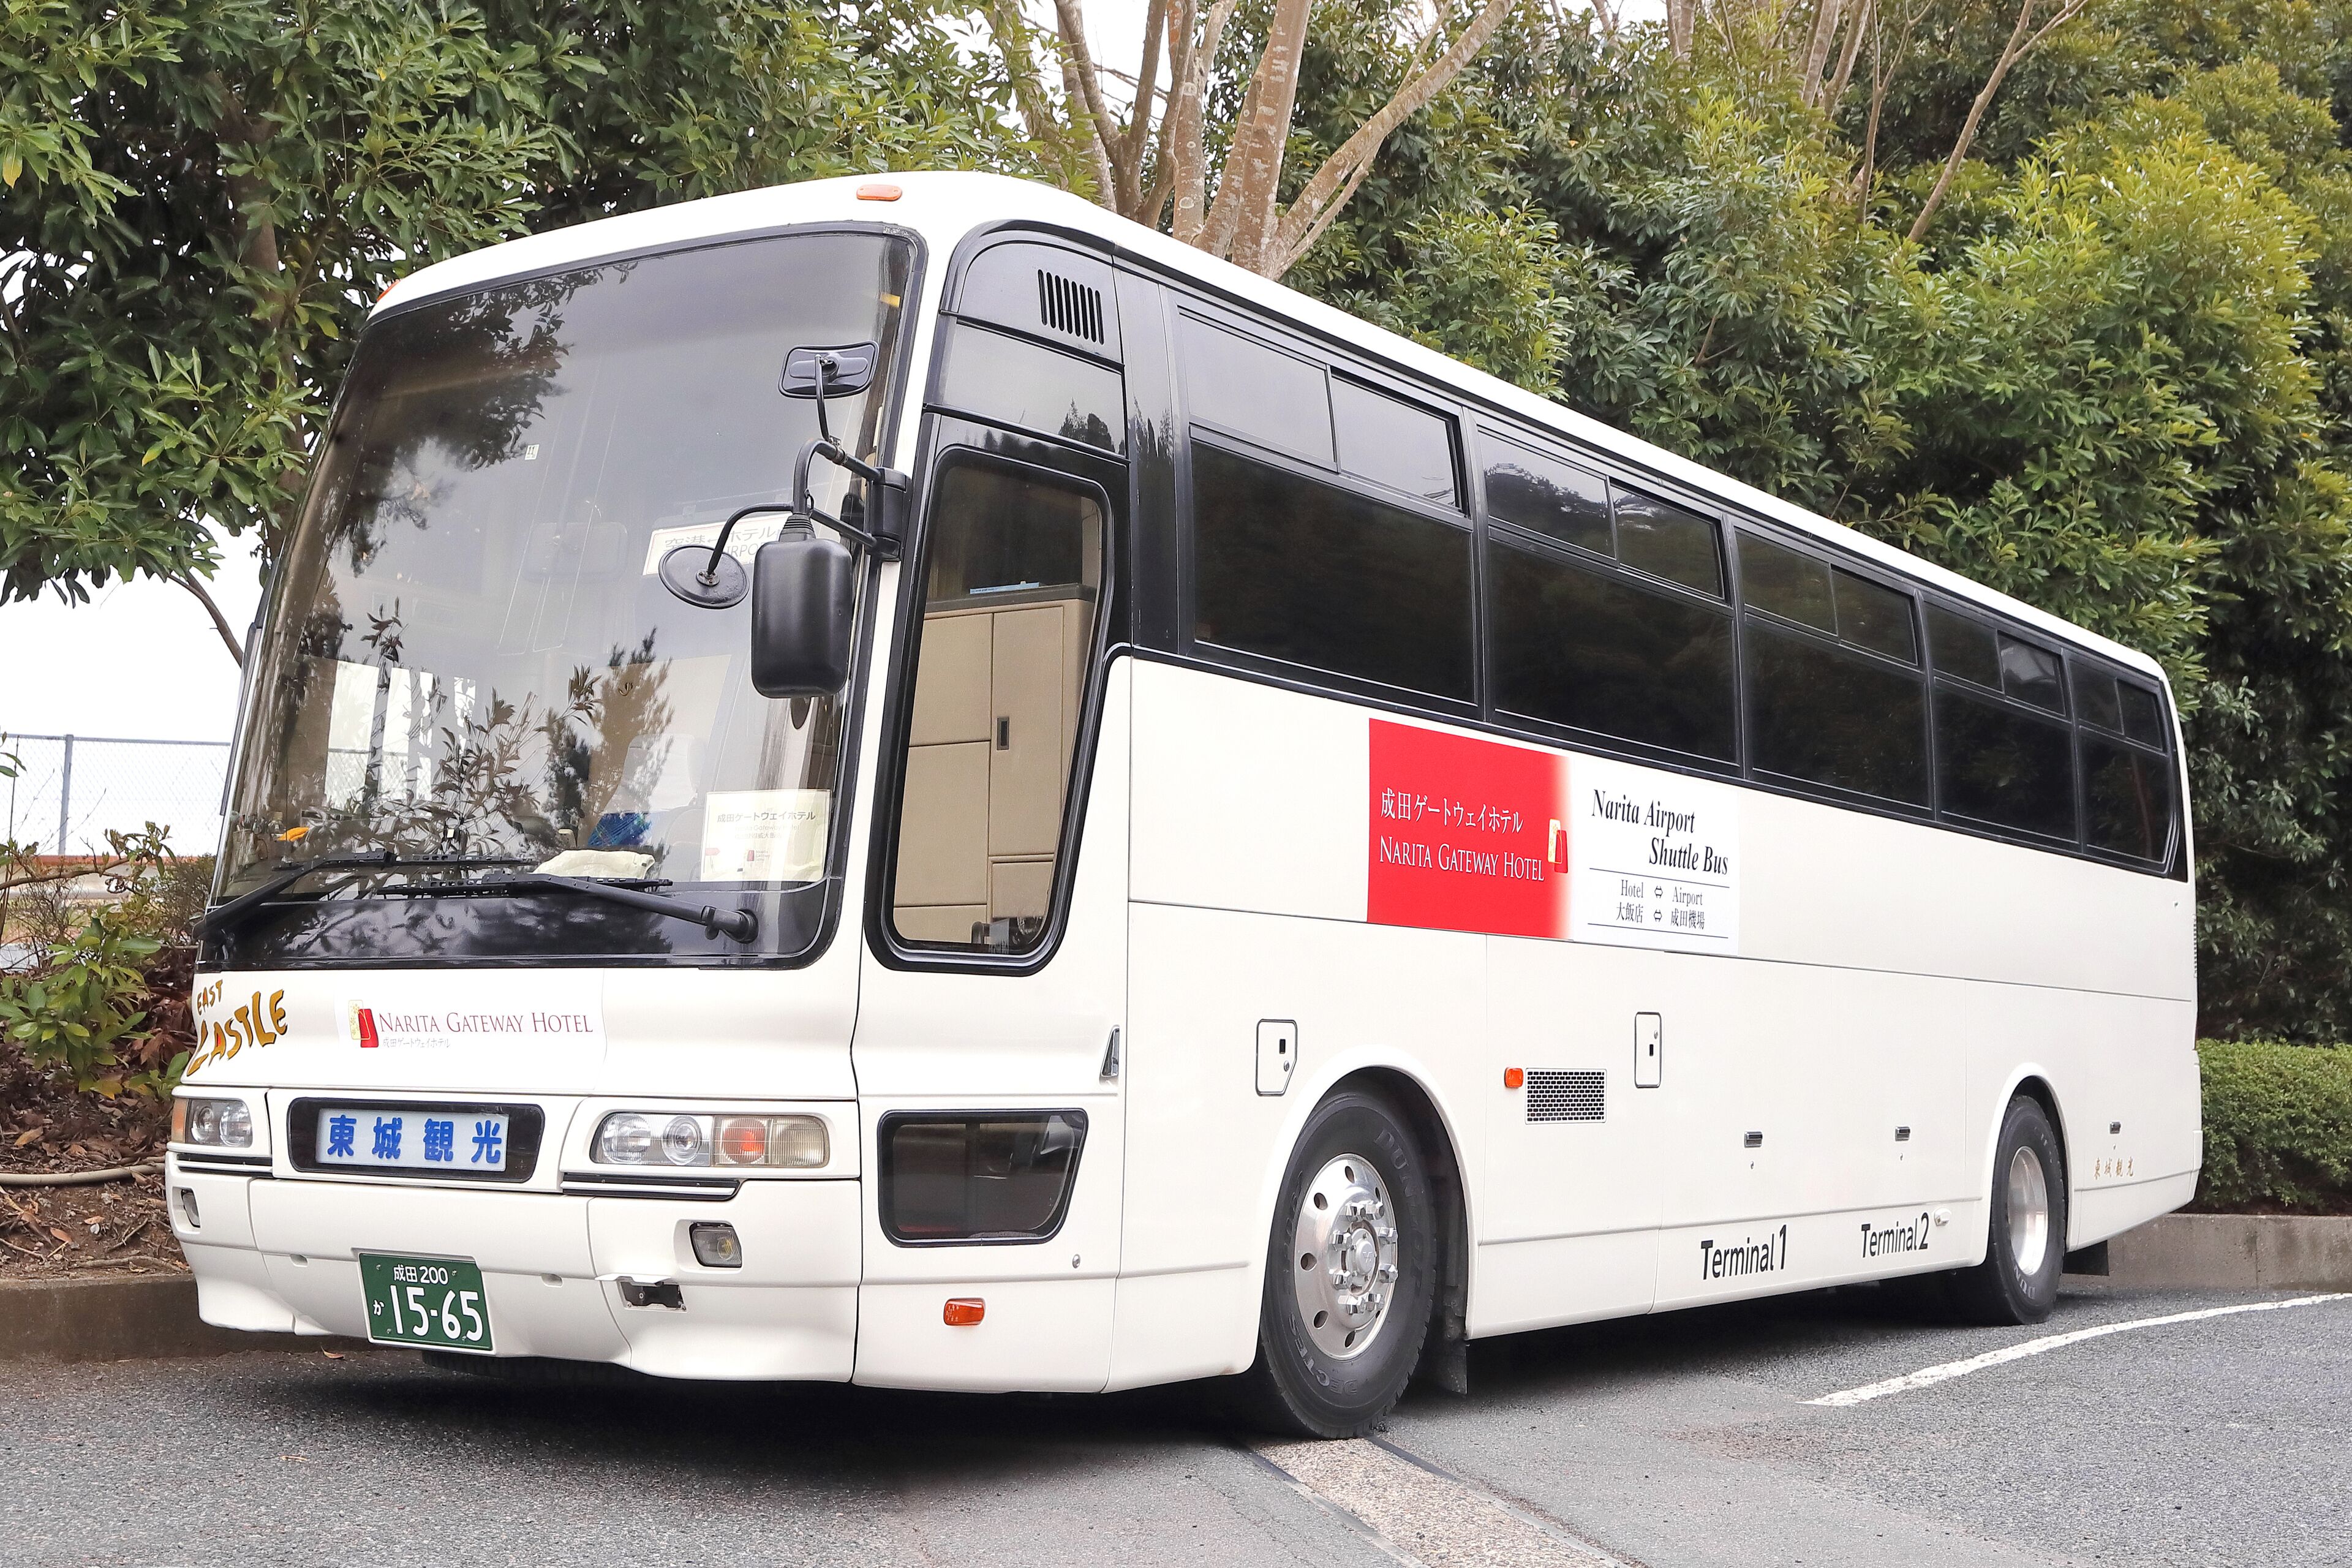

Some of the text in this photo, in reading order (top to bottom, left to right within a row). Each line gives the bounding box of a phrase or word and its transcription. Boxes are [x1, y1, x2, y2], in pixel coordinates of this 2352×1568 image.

[1381, 787, 1524, 834] 成田ゲートウェイホテル
[1591, 789, 1695, 837] Narita Airport
[1380, 835, 1545, 881] NARITA GATEWAY HOTEL
[1649, 837, 1728, 875] Shuttle Bus
[1616, 902, 1705, 930] 大飯店 成田機場
[1621, 879, 1703, 907] Hotel Airport
[197, 979, 223, 1016] EAST
[186, 989, 288, 1077] CASTLE
[379, 1012, 594, 1033] NARITA GATEWAY HOTEL
[327, 1114, 502, 1164] 東城観光
[1701, 1224, 1787, 1280] Terminal 1
[1861, 1212, 1929, 1258] Terminal 2
[393, 1264, 449, 1285] 成田 200
[372, 1284, 483, 1341] か 15-65
